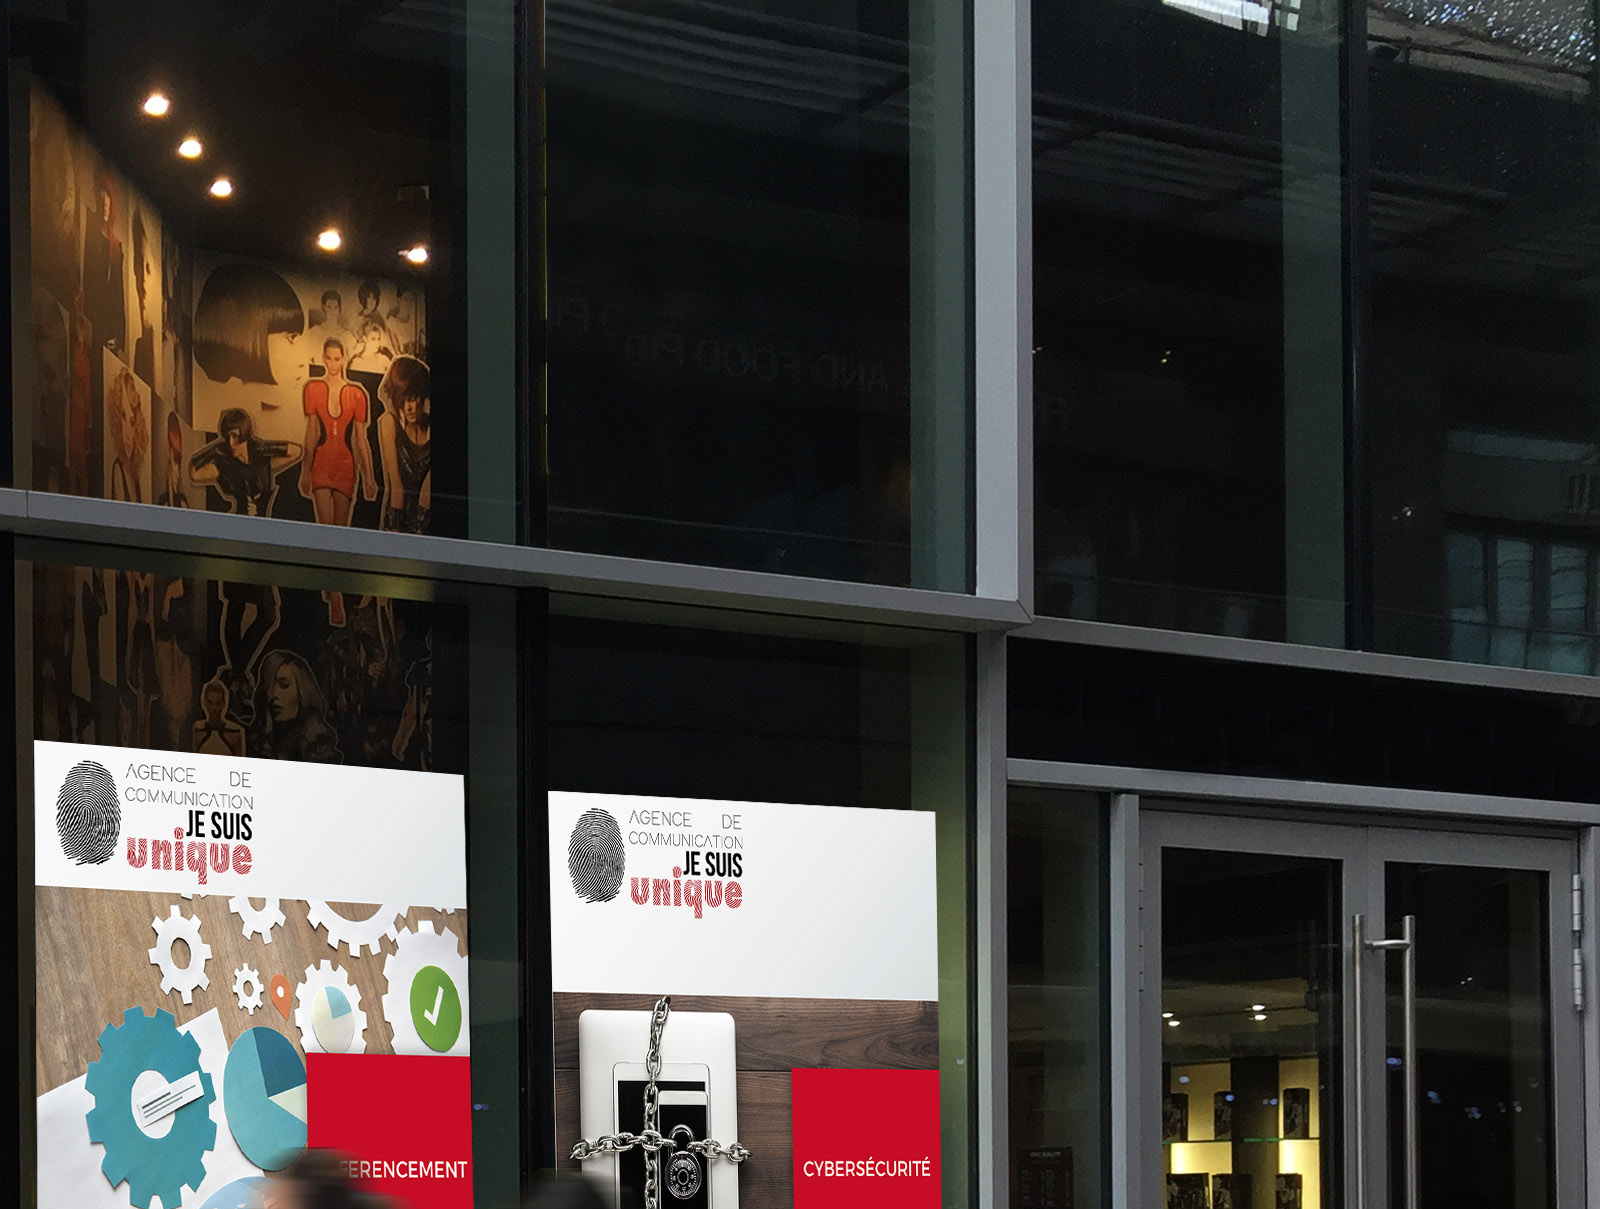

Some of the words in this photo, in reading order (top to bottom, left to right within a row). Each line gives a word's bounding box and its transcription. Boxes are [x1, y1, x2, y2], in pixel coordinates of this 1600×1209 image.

[125, 763, 196, 784] AGENCE
[229, 770, 252, 788] DE
[124, 786, 254, 810] COMMUNICATION
[186, 809, 205, 838] JE
[211, 811, 253, 841] SUIS
[629, 810, 692, 827] AGENCE
[722, 814, 742, 829] DE
[629, 831, 743, 849] COMMUNICATION
[126, 826, 253, 885] unique
[683, 850, 700, 876] JE
[705, 851, 743, 877] SUIS
[630, 866, 743, 919] unique
[803, 1156, 931, 1177] CYBERSÉCURITÉ
